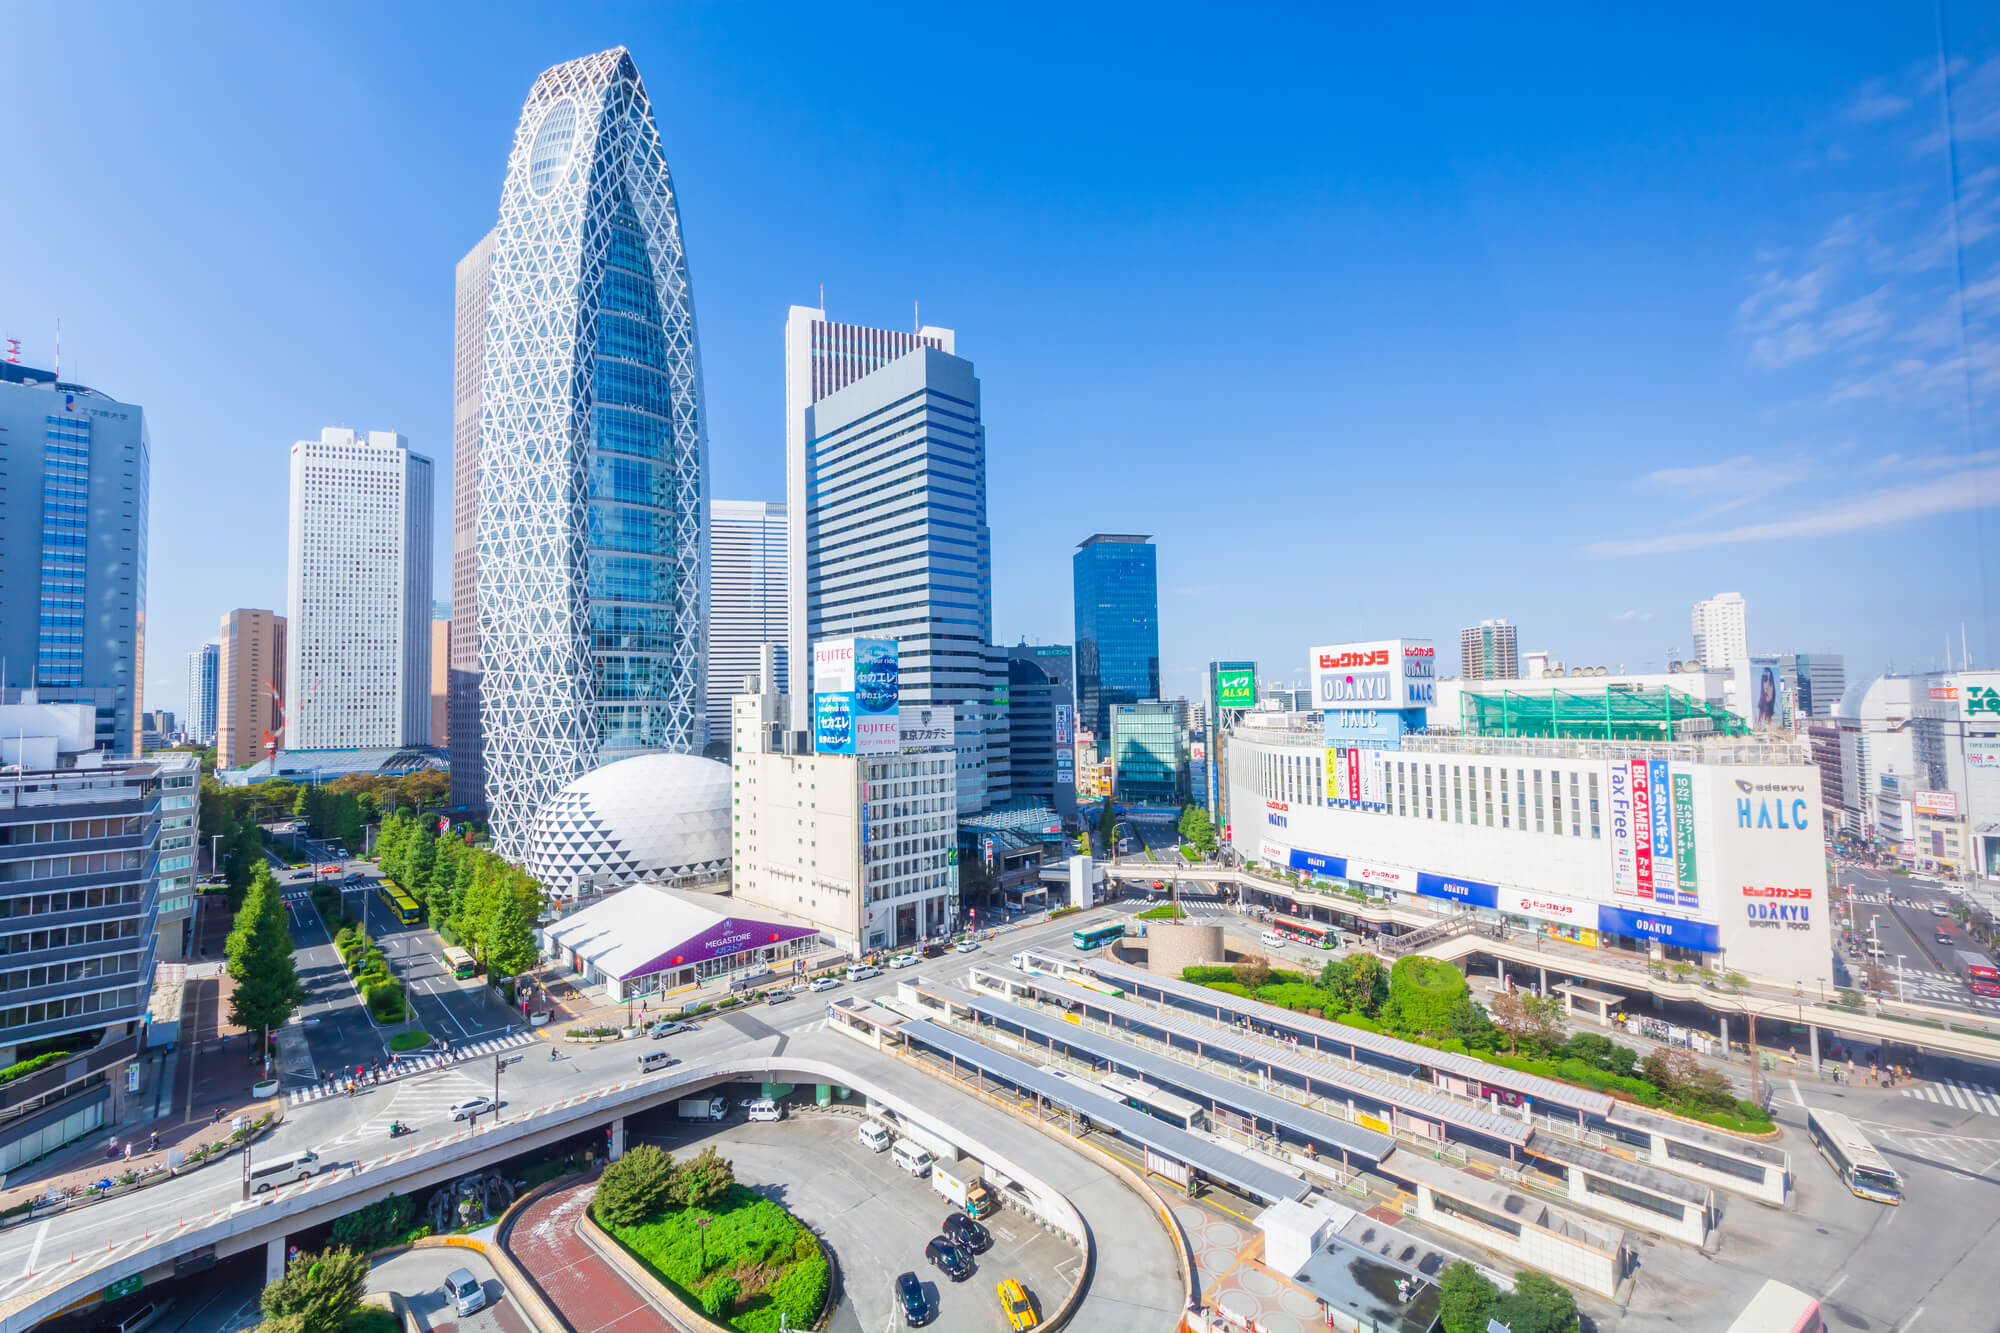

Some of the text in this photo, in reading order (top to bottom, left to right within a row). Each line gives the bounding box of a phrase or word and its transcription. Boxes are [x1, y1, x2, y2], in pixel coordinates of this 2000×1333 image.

[816, 648, 853, 664] FUJITEC
[1320, 650, 1389, 668] ビックカメラ
[1405, 661, 1434, 677] ODAKYU
[1222, 677, 1249, 687] レイク
[1324, 675, 1386, 700] ODAKYU
[1222, 688, 1250, 697] ALSA
[1409, 684, 1433, 701] HALC
[1340, 709, 1378, 728] HALC
[857, 723, 897, 735] FUJITEC
[899, 728, 953, 741] 東京アカデミー
[1632, 765, 1647, 789] BIC
[1612, 764, 1630, 839] Tax Free
[1634, 790, 1651, 850] CAMERA
[1654, 783, 1670, 855] ハルクスポーツ
[1737, 793, 1808, 830] HALC
[1743, 886, 1812, 899] ビックカメラ
[1748, 902, 1809, 921] ODAKYU
[1636, 919, 1673, 936] ODAKYU
[705, 932, 751, 949] MEGASTORE
